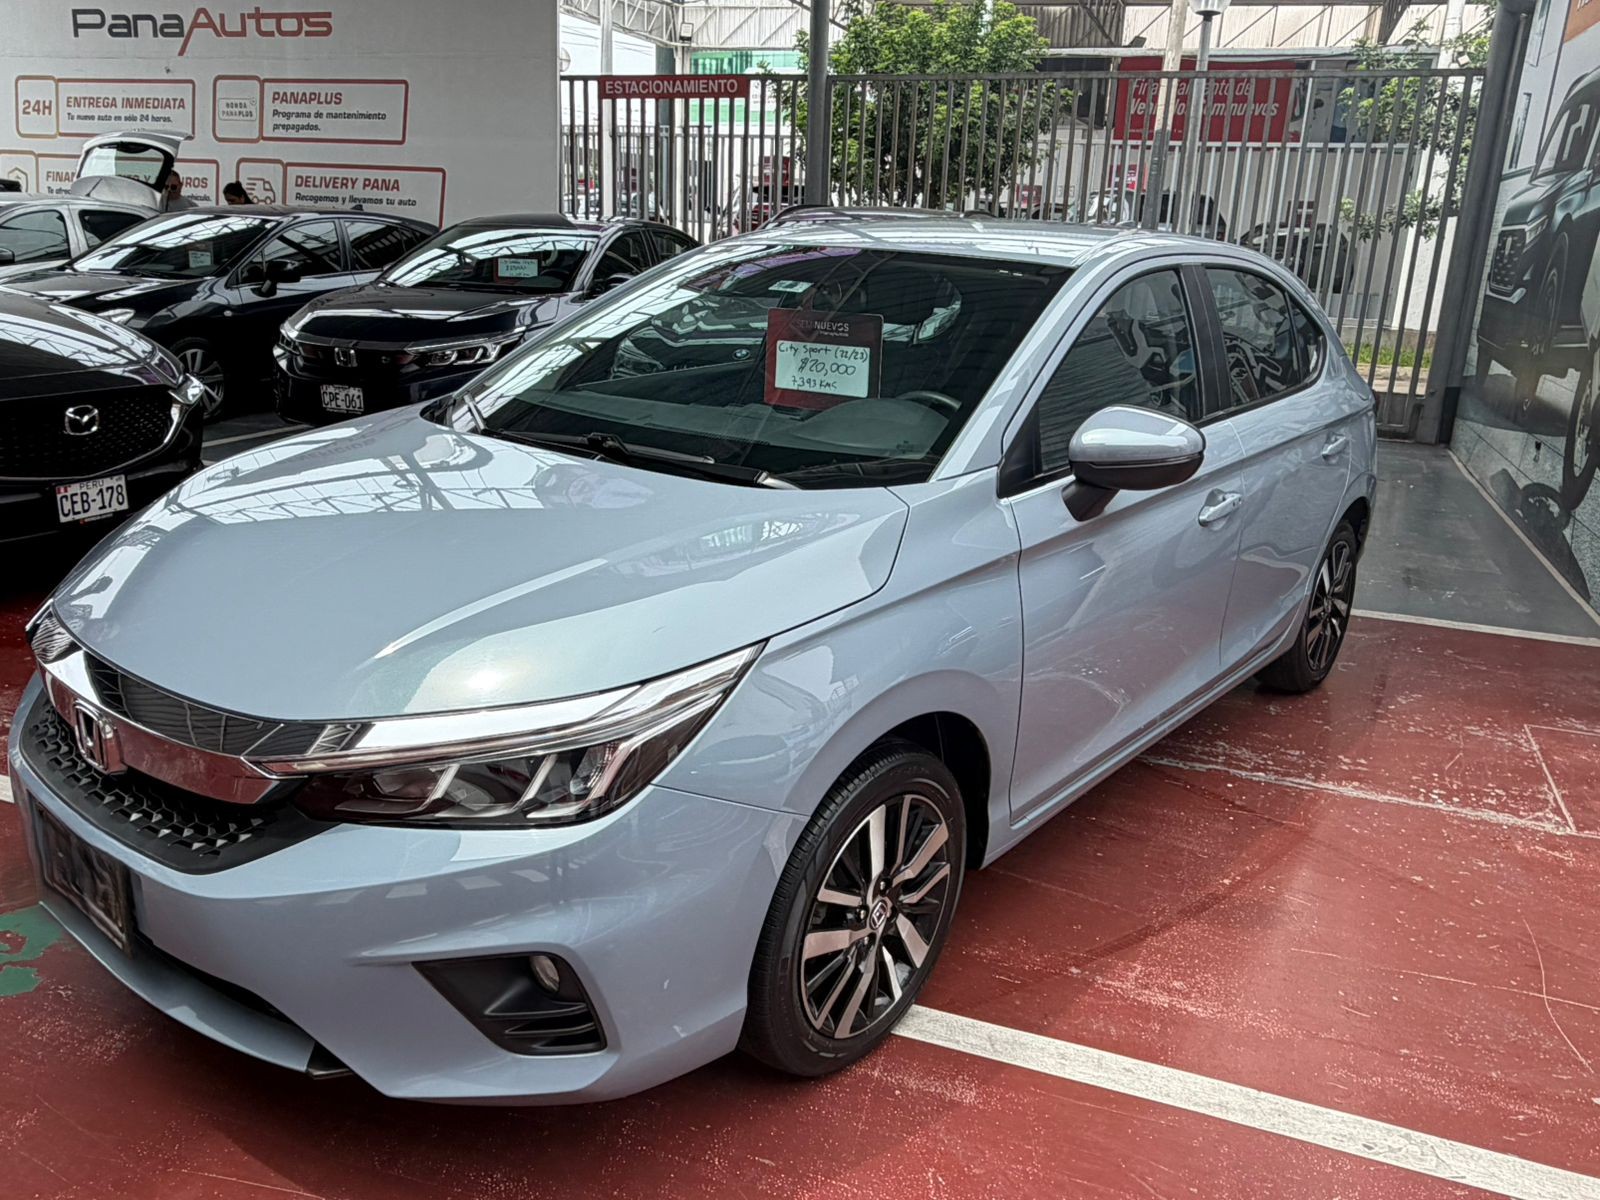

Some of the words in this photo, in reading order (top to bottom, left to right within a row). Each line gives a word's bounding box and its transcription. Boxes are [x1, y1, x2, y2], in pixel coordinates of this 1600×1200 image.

[71, 6, 333, 57] PanaAutos
[605, 79, 738, 94] ESTACIONAMIENTO
[66, 96, 118, 109] ENTREGA
[121, 97, 186, 110] INMEDIATA
[272, 91, 343, 105] PANAPLUS
[22, 99, 53, 116] 24H
[272, 109, 312, 120] Programa
[314, 110, 324, 119] de
[326, 111, 387, 121] mantenimiento
[67, 113, 75, 121] Tu
[97, 114, 112, 122] auto
[139, 114, 150, 122] 24
[151, 114, 173, 123] horas.
[272, 122, 321, 133] prepagados.
[295, 175, 358, 189] DELIVERY
[362, 177, 400, 191] PANA
[295, 192, 339, 204] Recogemos
[341, 196, 347, 205] y
[348, 194, 383, 205] llevamos
[386, 197, 395, 206] tu
[397, 198, 417, 207] auto
[778, 342, 799, 357] City
[803, 345, 831, 358] Sport
[834, 347, 869, 363] (22/23)
[798, 357, 857, 377] $20,000
[322, 391, 363, 410] CPE-061
[59, 483, 125, 518] CEB-178
